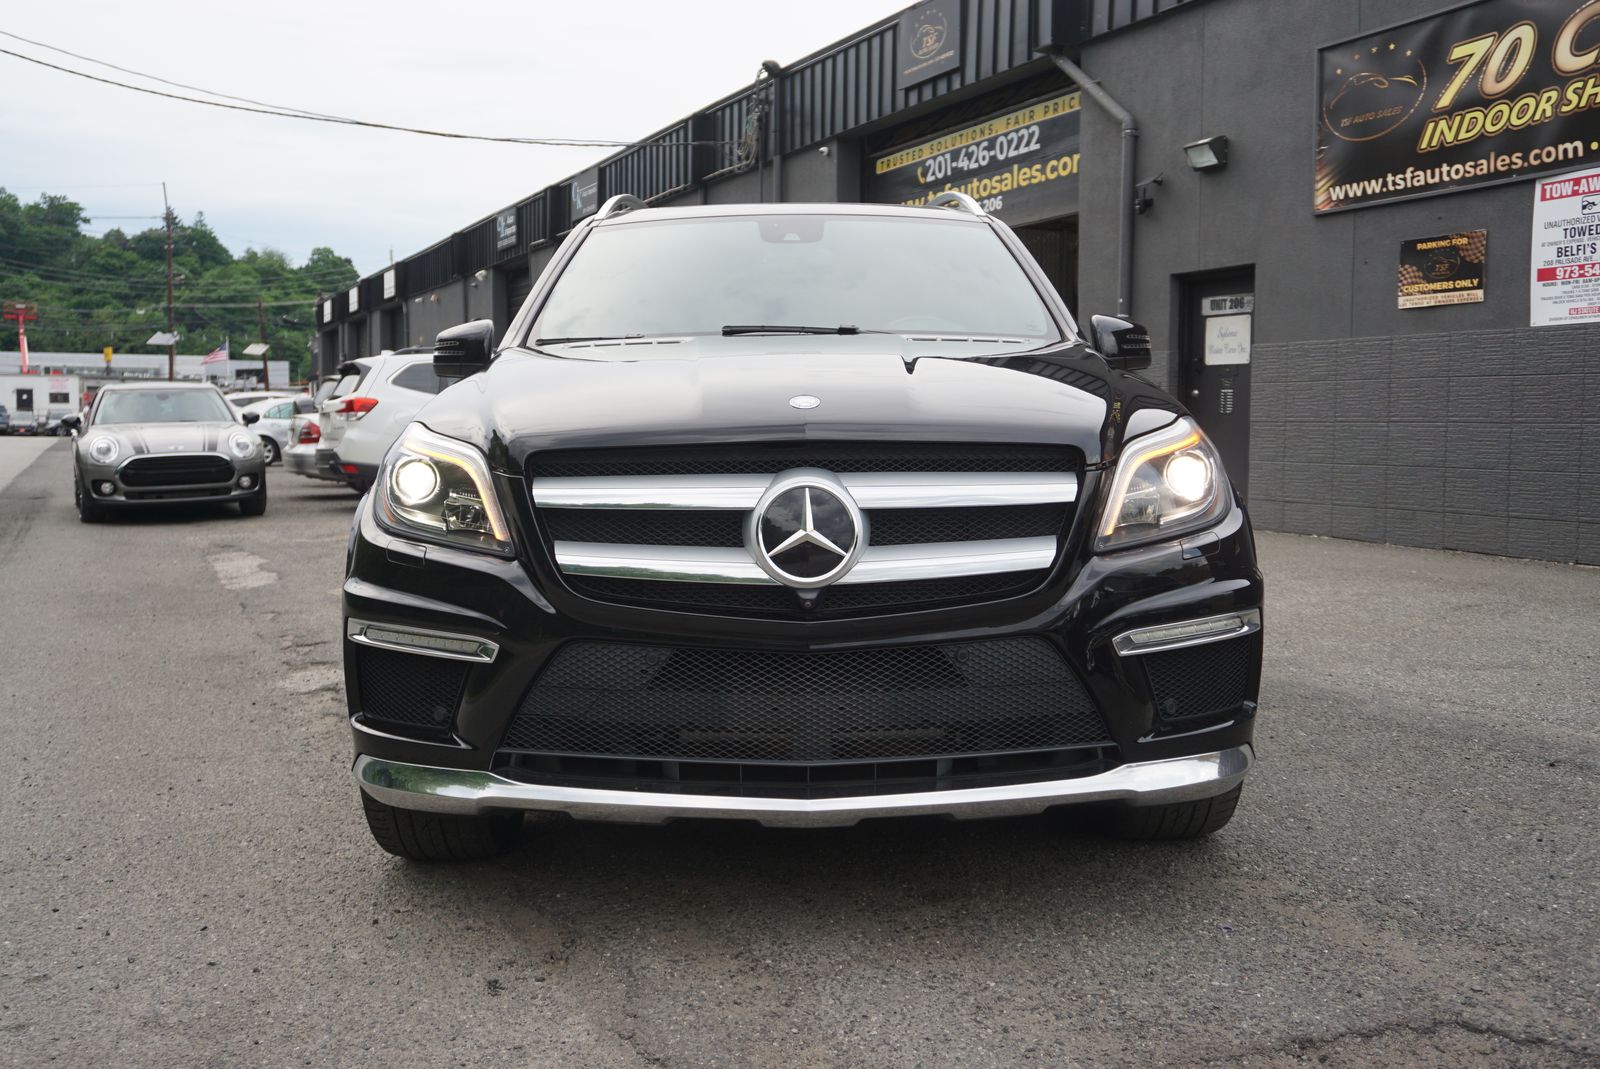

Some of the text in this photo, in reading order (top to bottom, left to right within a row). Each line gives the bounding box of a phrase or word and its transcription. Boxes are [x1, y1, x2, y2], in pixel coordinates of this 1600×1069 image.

[1434, 21, 1537, 111] 70
[1353, 112, 1376, 124] AUTO
[1376, 106, 1404, 118] SALES
[1419, 89, 1559, 151] INDOOR
[880, 146, 924, 170] TRUSTED
[1006, 110, 1036, 128] FAIR
[1043, 94, 1081, 117] PRIC
[926, 124, 1041, 182] 201-426-0222
[1329, 140, 1584, 201] www.tsfautosales.com
[982, 196, 1003, 212] 206
[1544, 214, 1596, 230] UNAUTHORIZED
[1563, 224, 1600, 239] TOWED
[1416, 237, 1468, 250] PARKING FOR
[1556, 242, 1597, 258] BELFI'S
[1555, 257, 1581, 265] PALISADE
[1556, 264, 1600, 279] 973-54
[1403, 279, 1479, 293] CUSTOMERS ONLY
[1210, 299, 1228, 311] UNIT
